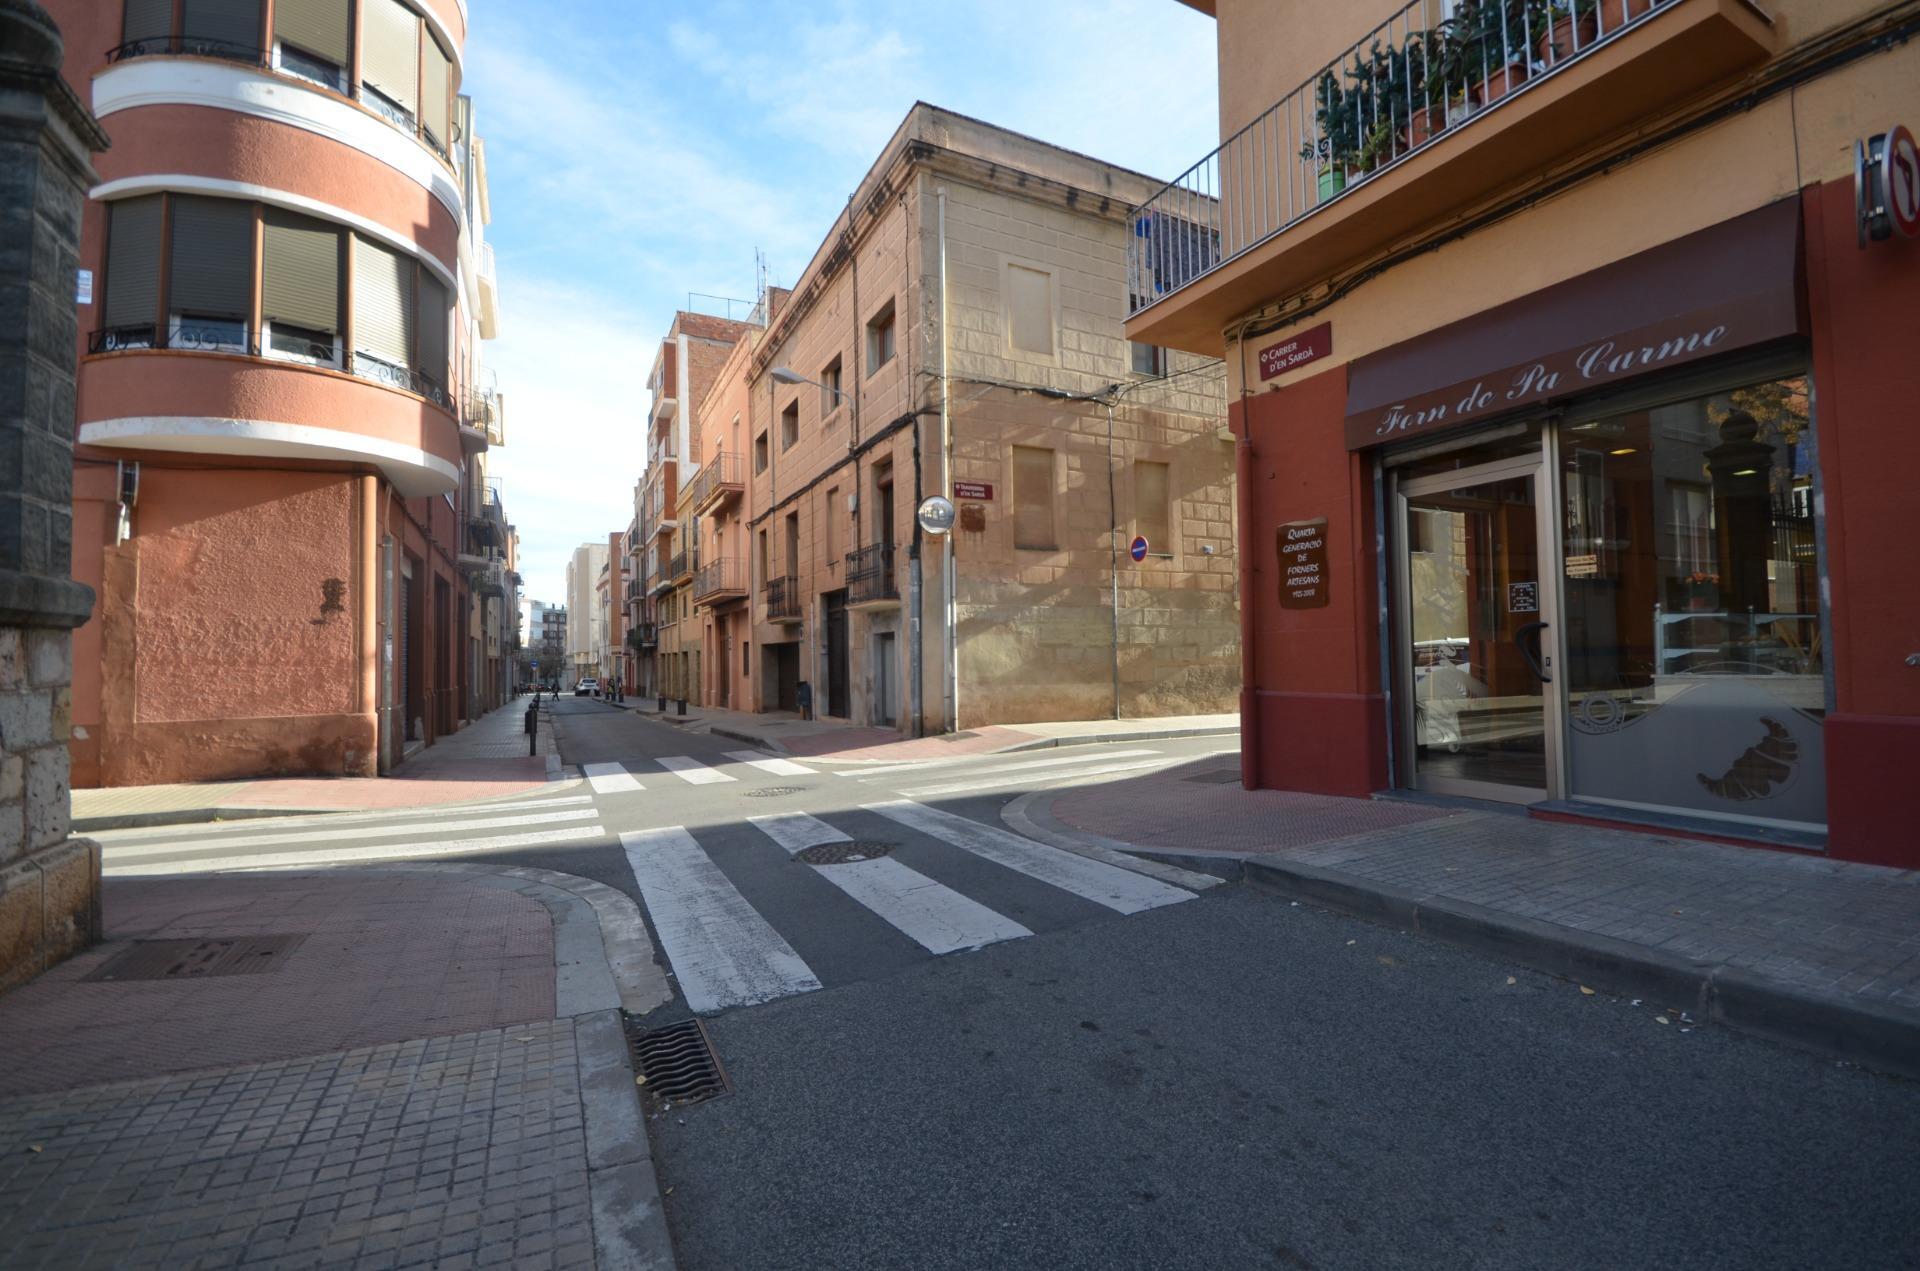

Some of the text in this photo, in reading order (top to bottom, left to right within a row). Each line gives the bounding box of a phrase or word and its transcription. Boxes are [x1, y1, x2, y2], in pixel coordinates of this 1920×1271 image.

[1269, 342, 1297, 360] CARRER
[1375, 325, 1727, 436] Forn de Pa Carme
[1288, 528, 1316, 540] QUARTA
[1298, 554, 1307, 562] DE
[1287, 563, 1319, 575] FORNERS
[1287, 575, 1320, 587] ARTESANS
